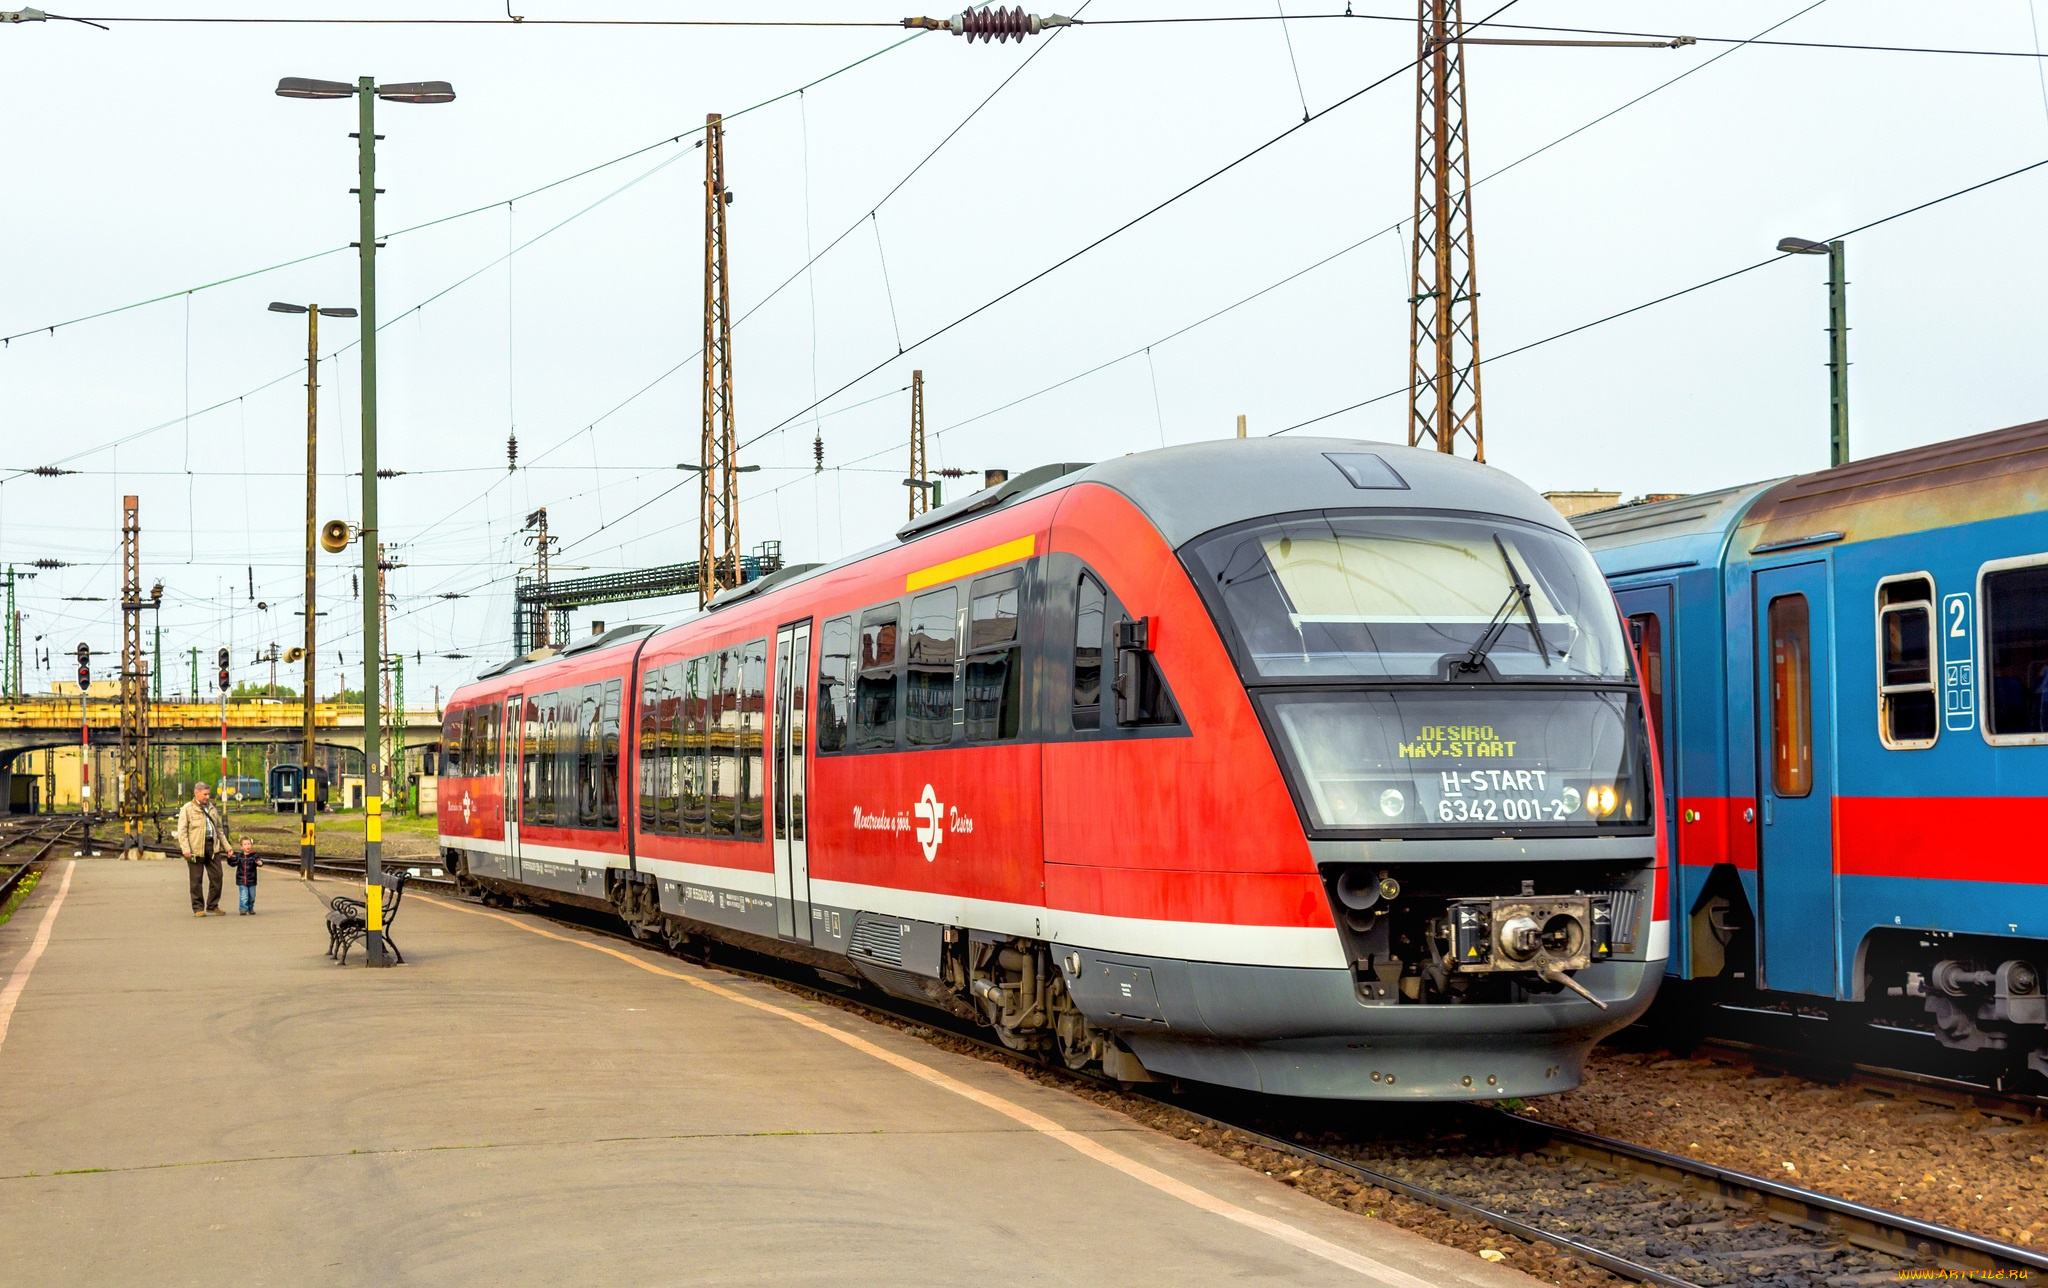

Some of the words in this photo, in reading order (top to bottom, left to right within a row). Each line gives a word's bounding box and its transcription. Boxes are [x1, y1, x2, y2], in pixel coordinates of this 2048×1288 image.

[1949, 598, 1966, 638] 2
[958, 612, 966, 657] 1
[1441, 770, 1547, 797] H-START
[950, 805, 974, 834] Desiro
[1438, 799, 1499, 822] 6342
[1502, 799, 1566, 821] 001-2
